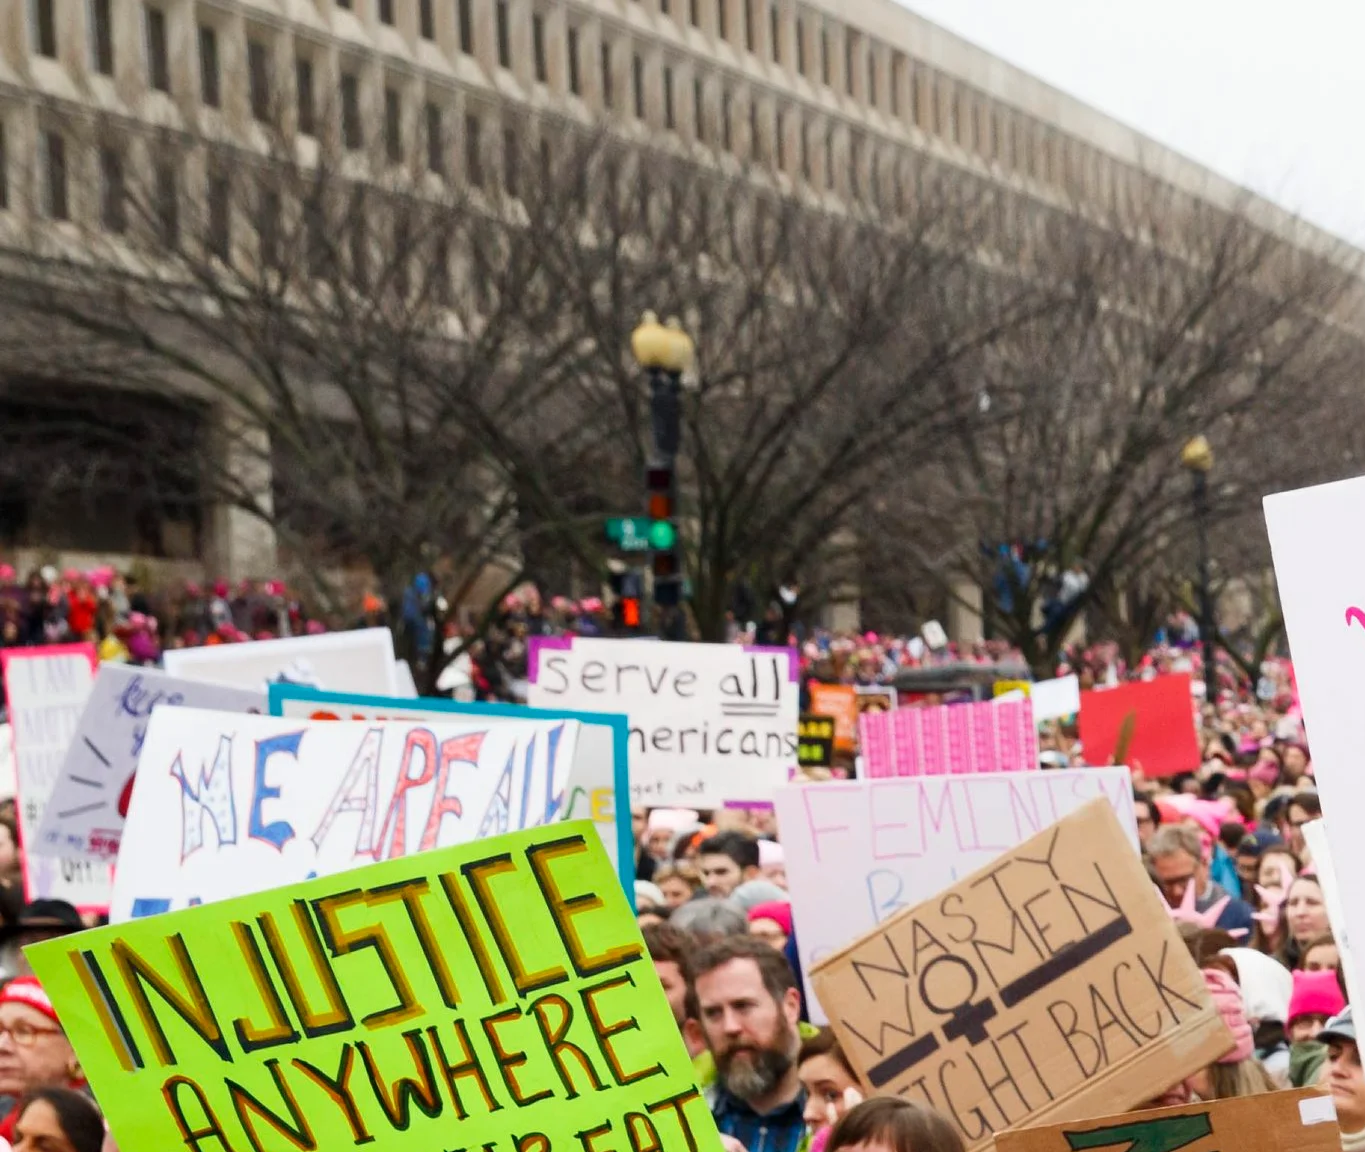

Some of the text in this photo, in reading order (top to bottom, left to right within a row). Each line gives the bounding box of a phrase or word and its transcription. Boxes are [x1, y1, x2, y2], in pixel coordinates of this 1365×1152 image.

[720, 657, 780, 701] all
[68, 834, 645, 1072] INJUSTICE
[850, 826, 1061, 1002] NASTY
[1047, 940, 1203, 1078] BACK
